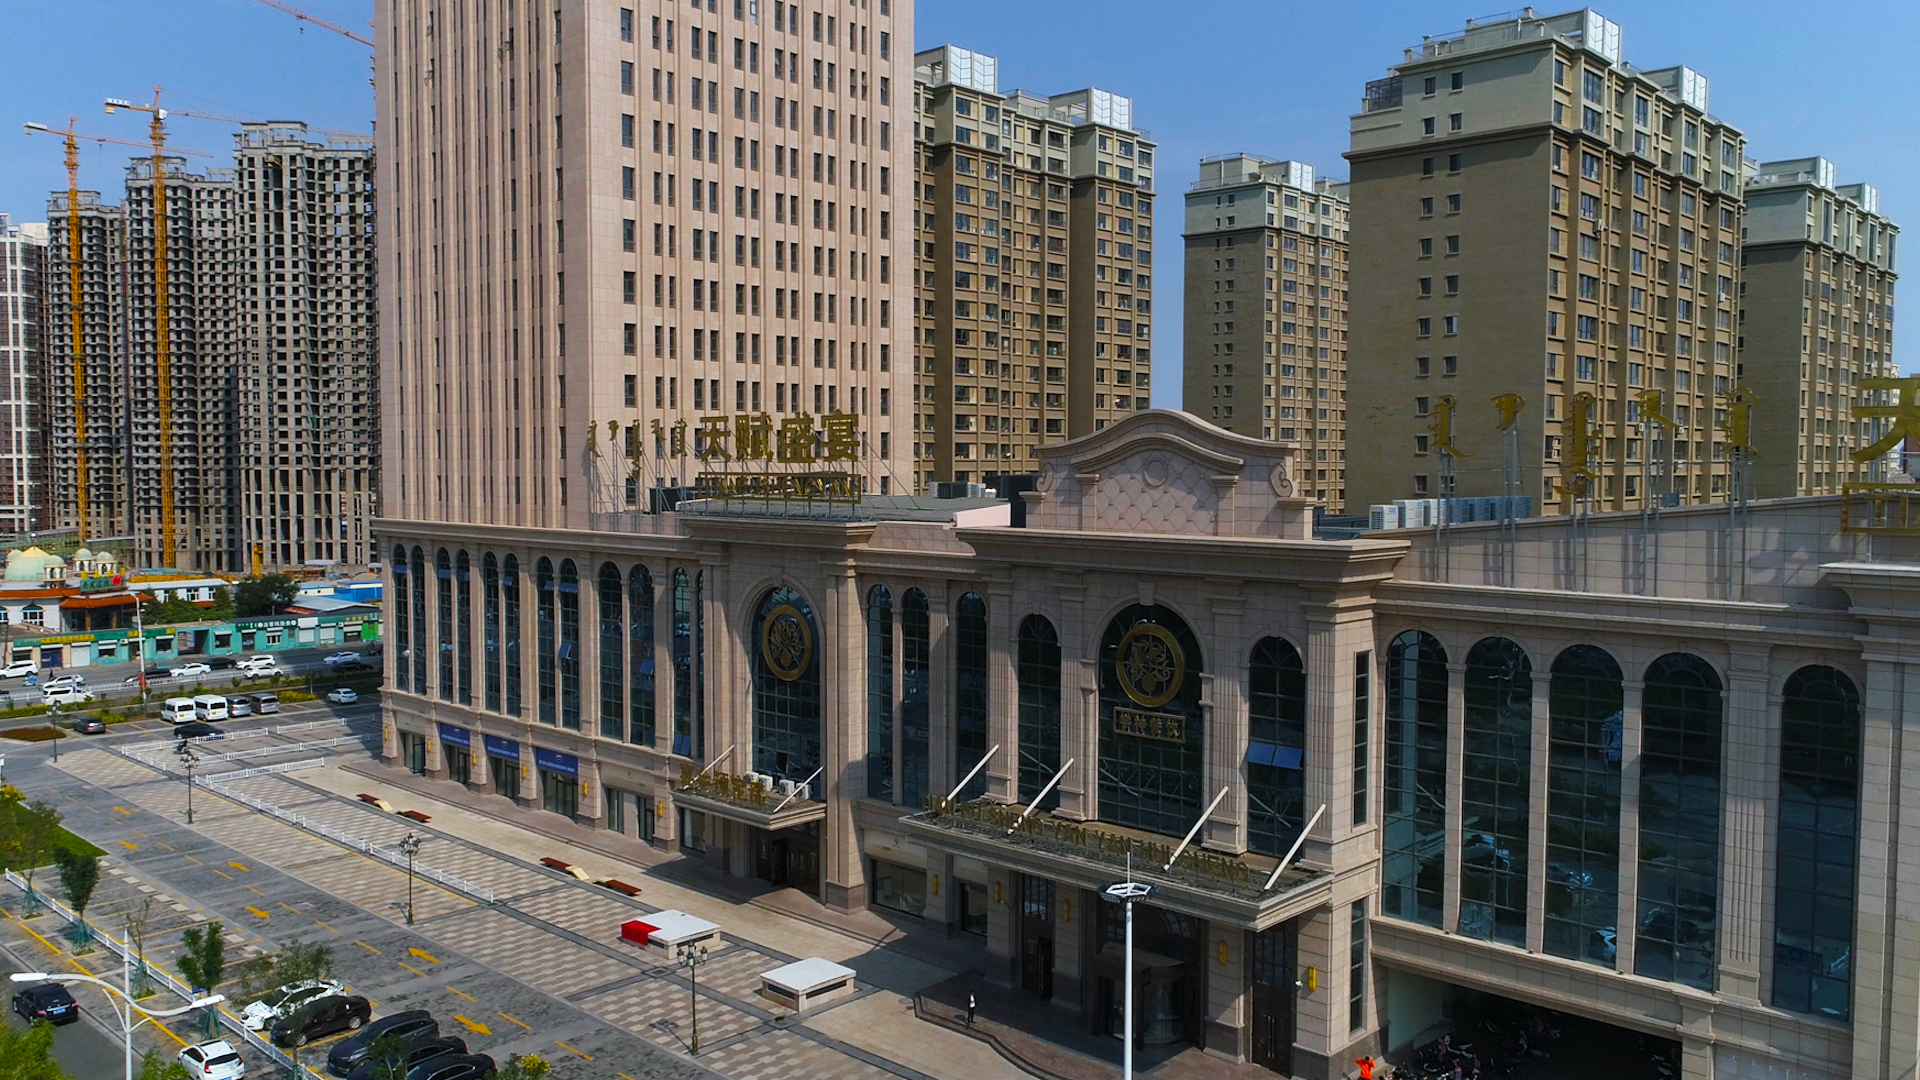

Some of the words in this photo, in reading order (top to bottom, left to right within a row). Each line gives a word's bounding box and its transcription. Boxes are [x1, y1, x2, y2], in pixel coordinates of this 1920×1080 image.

[698, 409, 861, 464] 天赋盛宴
[1179, 849, 1249, 884] CHENG
